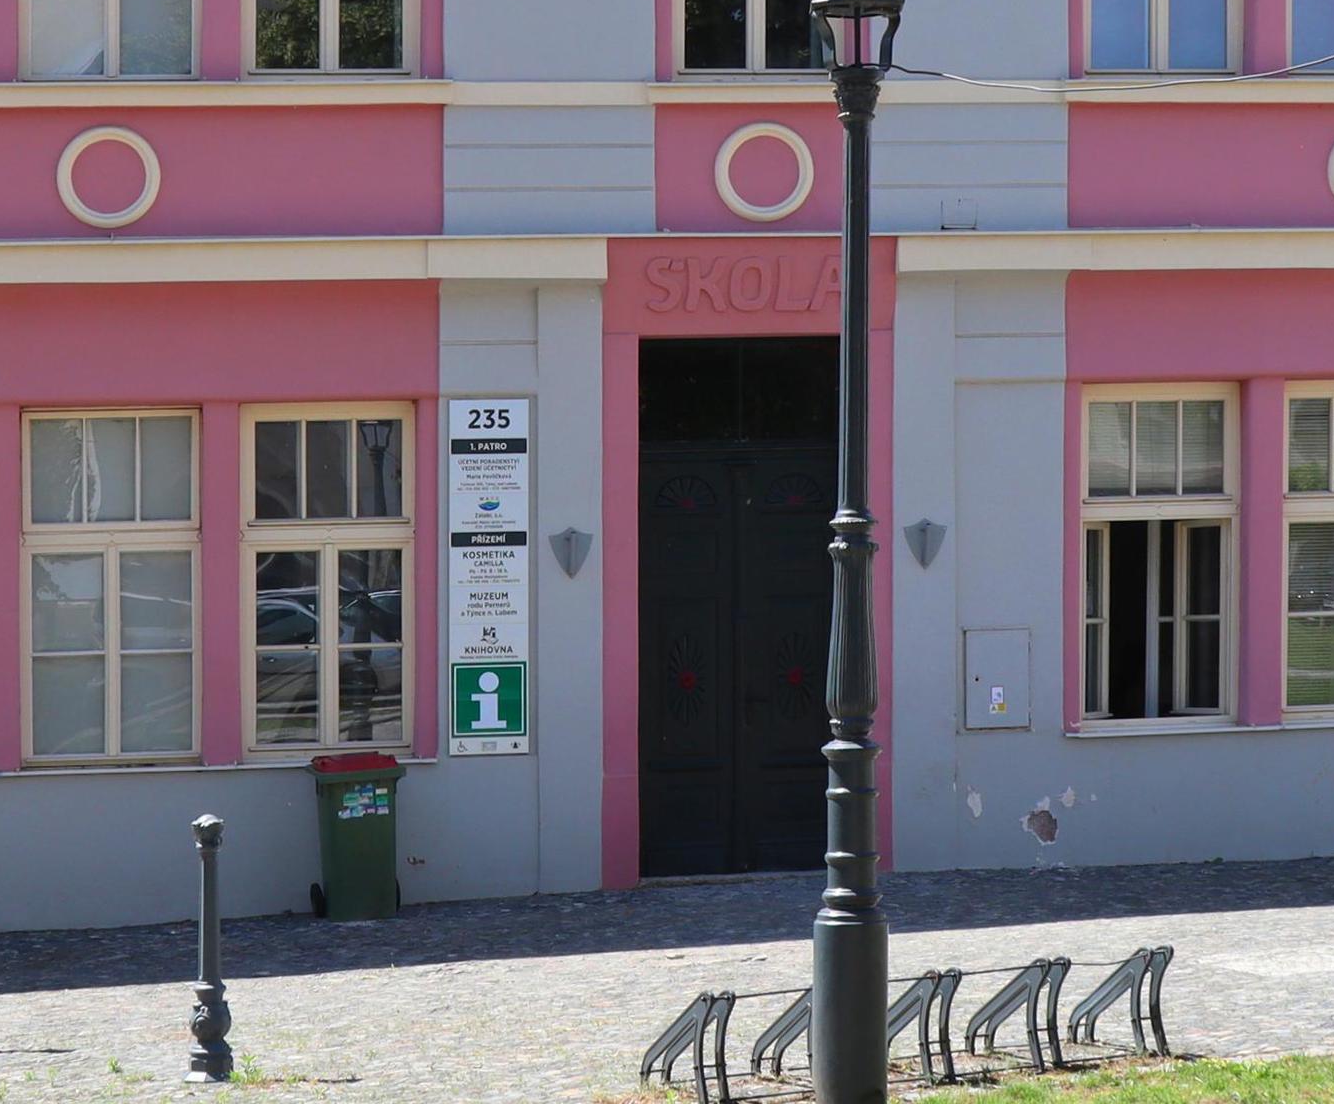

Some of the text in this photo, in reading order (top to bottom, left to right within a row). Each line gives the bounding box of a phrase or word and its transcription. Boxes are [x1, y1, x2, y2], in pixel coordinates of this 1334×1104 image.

[468, 409, 510, 429] 235
[470, 442, 507, 451] 1. PATRO
[471, 534, 506, 543] PŘÍZEMÍ
[463, 550, 515, 559] KOSMETIKA
[470, 591, 508, 600] MUZEUM
[464, 645, 513, 654] KNIHOVNA
